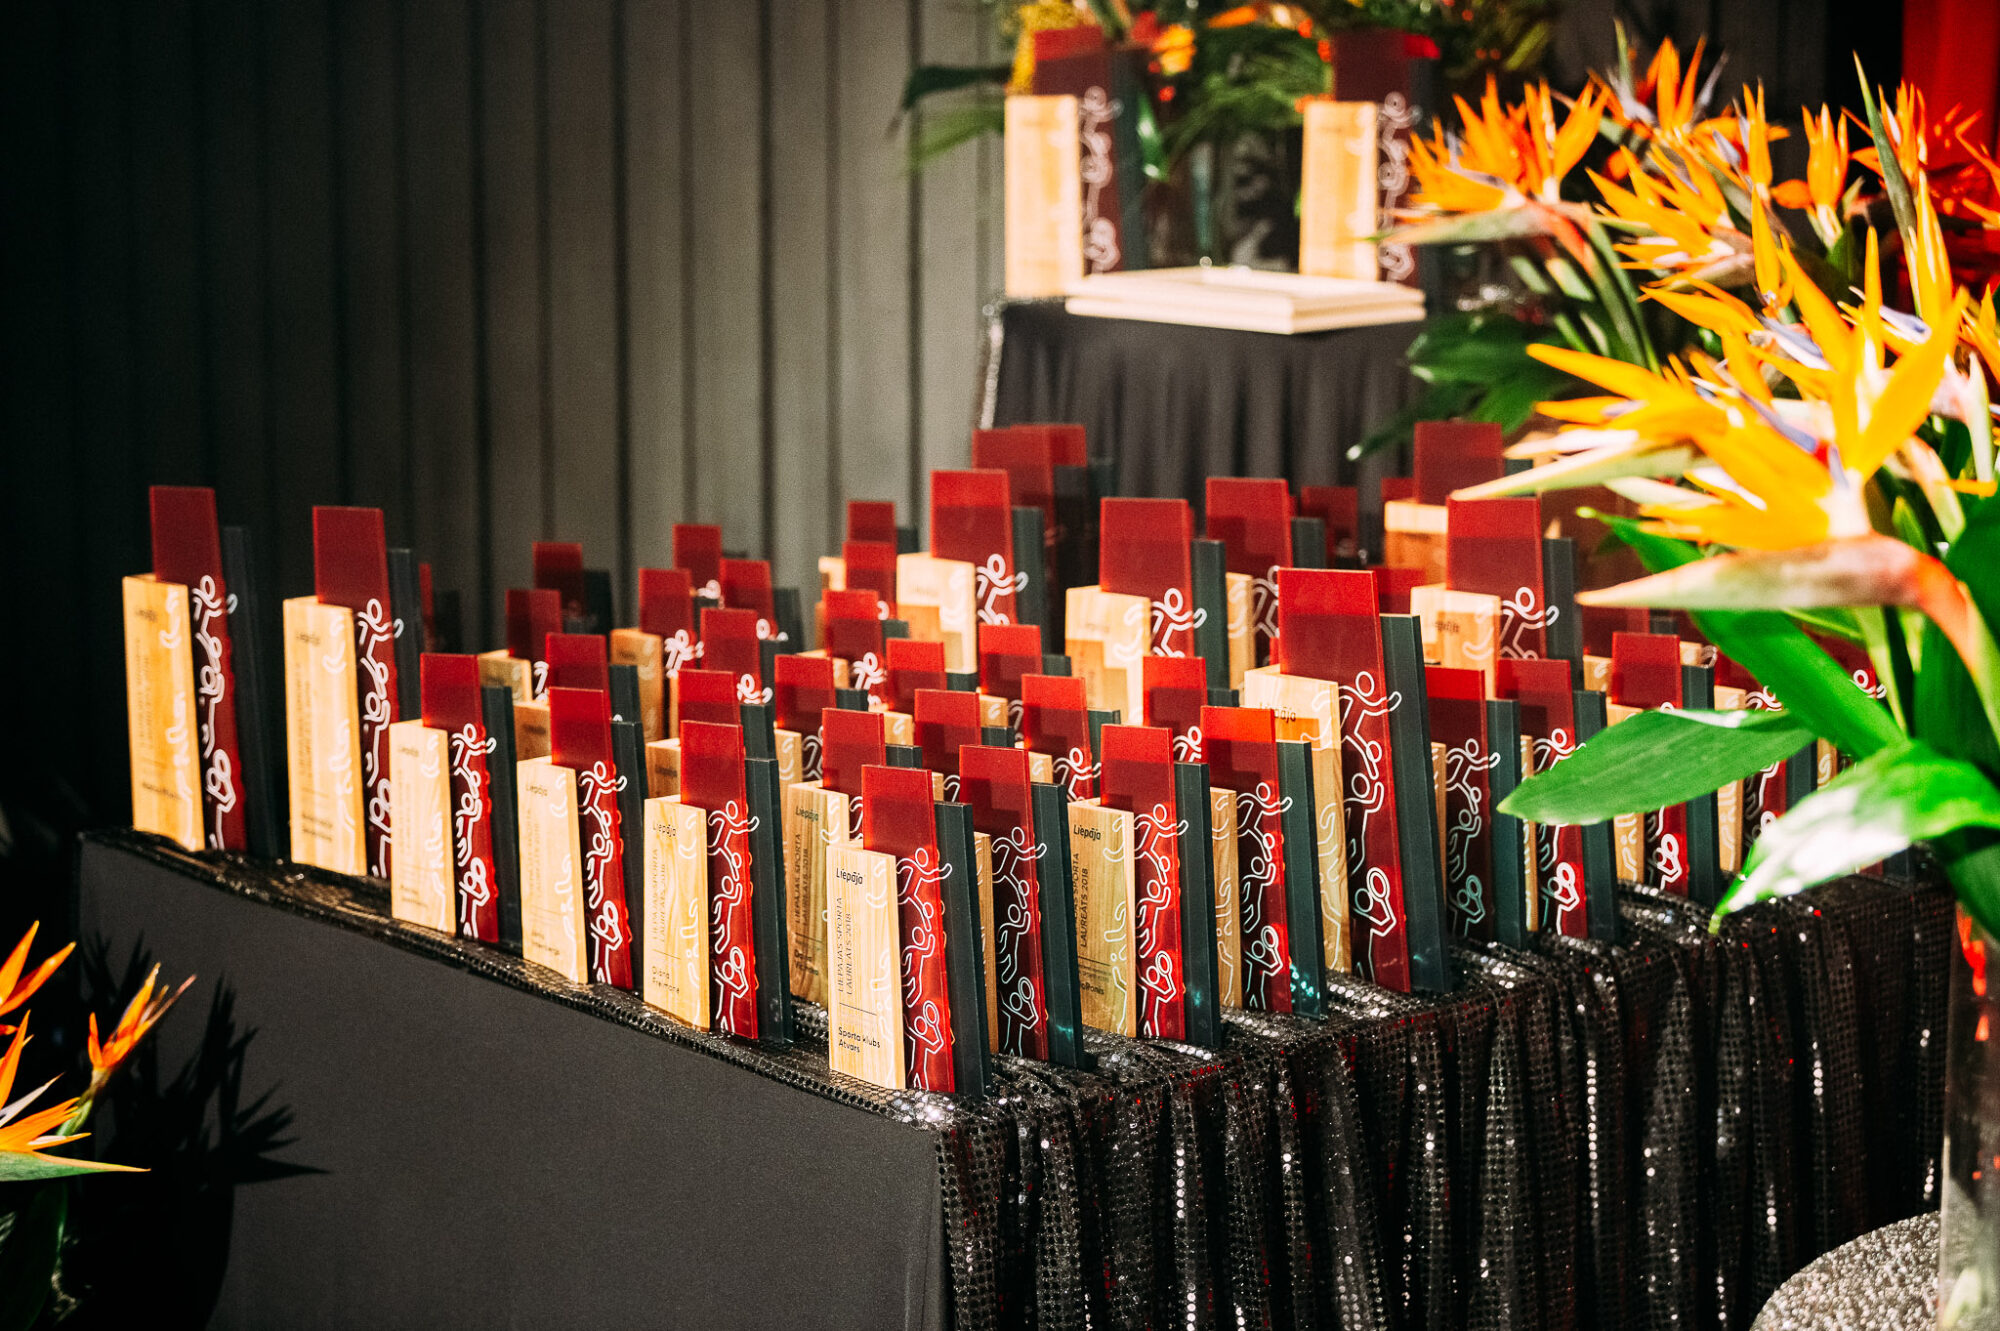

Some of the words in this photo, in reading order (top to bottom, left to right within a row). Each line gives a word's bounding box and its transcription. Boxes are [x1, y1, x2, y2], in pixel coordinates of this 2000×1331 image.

[795, 805, 819, 823] Liepāja
[1073, 824, 1102, 841] Liepāja
[836, 867, 863, 886] Liepāja
[844, 913, 852, 936] 2018
[838, 1026, 861, 1042] Sporta
[862, 1035, 881, 1049] klubs
[839, 1039, 860, 1053] Atvars
